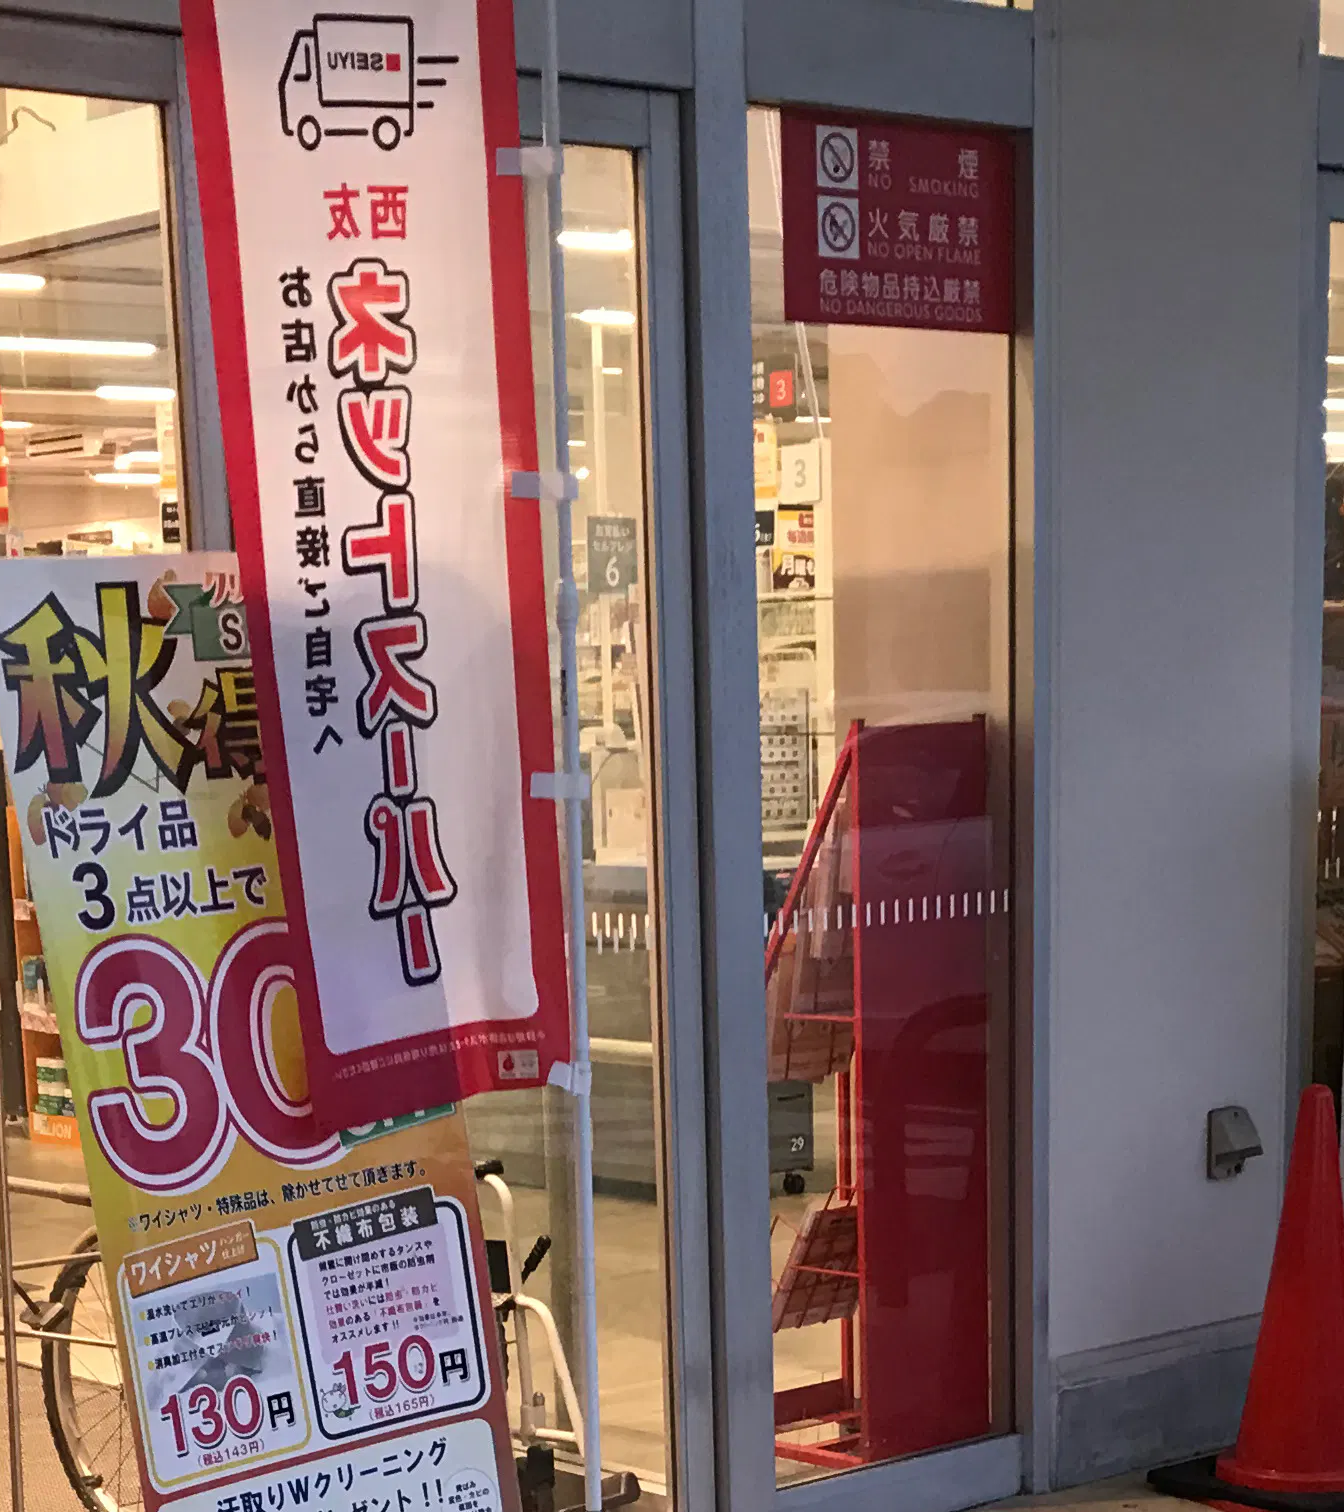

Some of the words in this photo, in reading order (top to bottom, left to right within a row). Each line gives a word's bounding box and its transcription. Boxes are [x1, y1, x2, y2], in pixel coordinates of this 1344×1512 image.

[868, 173, 892, 190] NO
[909, 176, 979, 199] SMOKING
[867, 207, 979, 247] 火気厳禁
[867, 240, 889, 258] NO
[894, 243, 932, 262] OPEN
[937, 247, 981, 265] FLAME
[819, 268, 981, 305] 危険物品持込厳禁
[819, 298, 840, 315] NO
[846, 300, 930, 320] DANGEROUS
[935, 303, 983, 323] GOODS
[606, 556, 620, 586] 6
[43, 800, 198, 859] ドライ品
[71, 861, 269, 931] 3点以上で
[791, 1136, 805, 1152] 29
[129, 1238, 218, 1285] ワイシャツ
[332, 1335, 470, 1408] 150円
[161, 1373, 297, 1458] 130円
